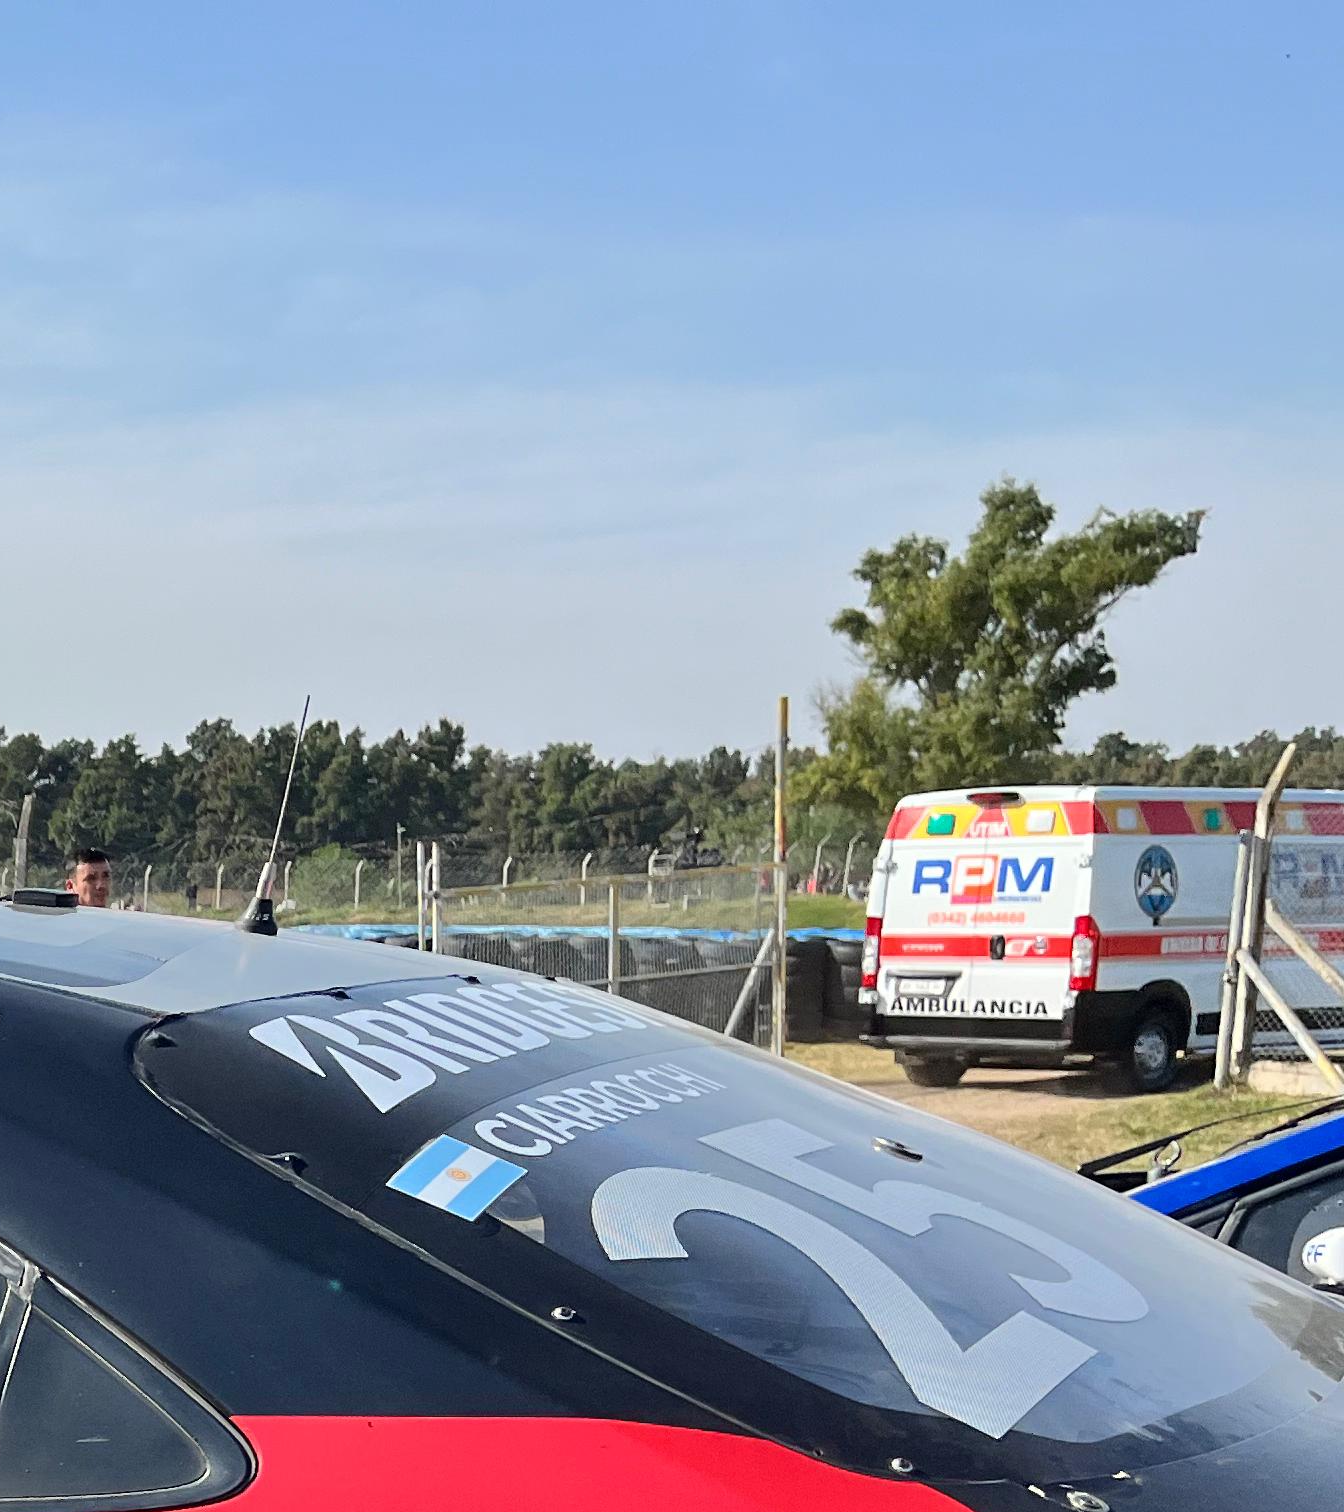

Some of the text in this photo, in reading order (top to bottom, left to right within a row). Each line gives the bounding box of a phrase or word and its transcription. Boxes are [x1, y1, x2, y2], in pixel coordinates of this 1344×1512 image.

[912, 856, 1055, 896] RPM
[890, 996, 1048, 1016] AMBULANCIA
[473, 1063, 728, 1158] CIARROCCHI
[590, 1118, 1148, 1439] 25
